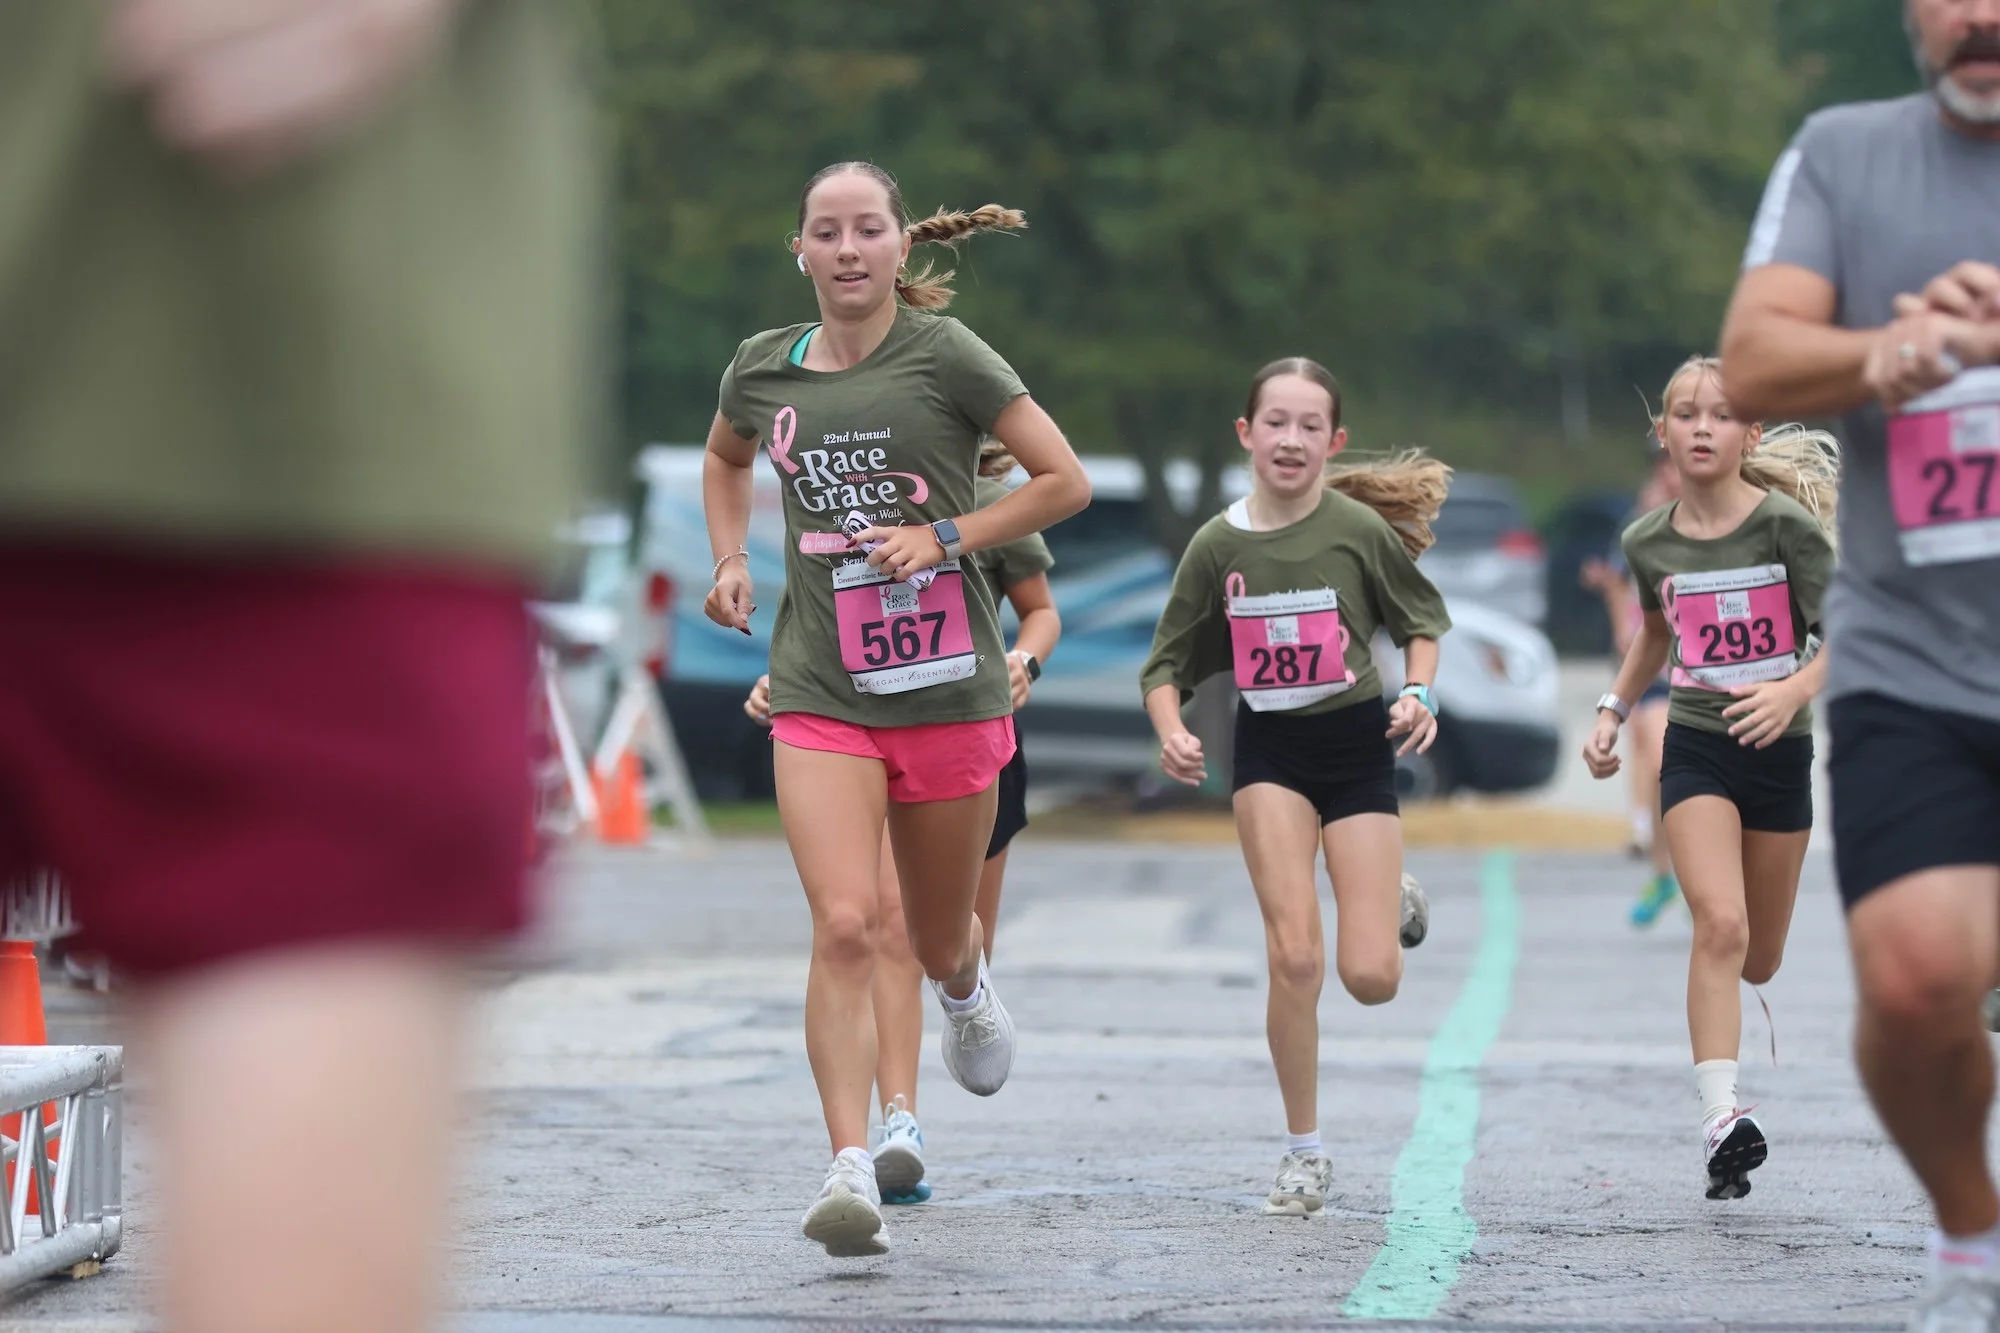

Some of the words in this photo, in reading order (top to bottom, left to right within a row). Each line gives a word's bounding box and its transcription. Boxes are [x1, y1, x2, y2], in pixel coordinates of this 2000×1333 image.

[823, 431, 849, 445] 22nd
[852, 427, 891, 442] Annual
[799, 447, 888, 489] Race
[844, 473, 868, 483] With
[793, 476, 898, 512] Grace
[1921, 454, 1997, 518] 27
[878, 508, 902, 520] Walk
[837, 575, 860, 584] Cleveland
[886, 599, 911, 610] Grace
[891, 593, 910, 603] Race
[861, 610, 947, 667] 567
[1699, 617, 1777, 663] 293
[1250, 644, 1322, 686] 287
